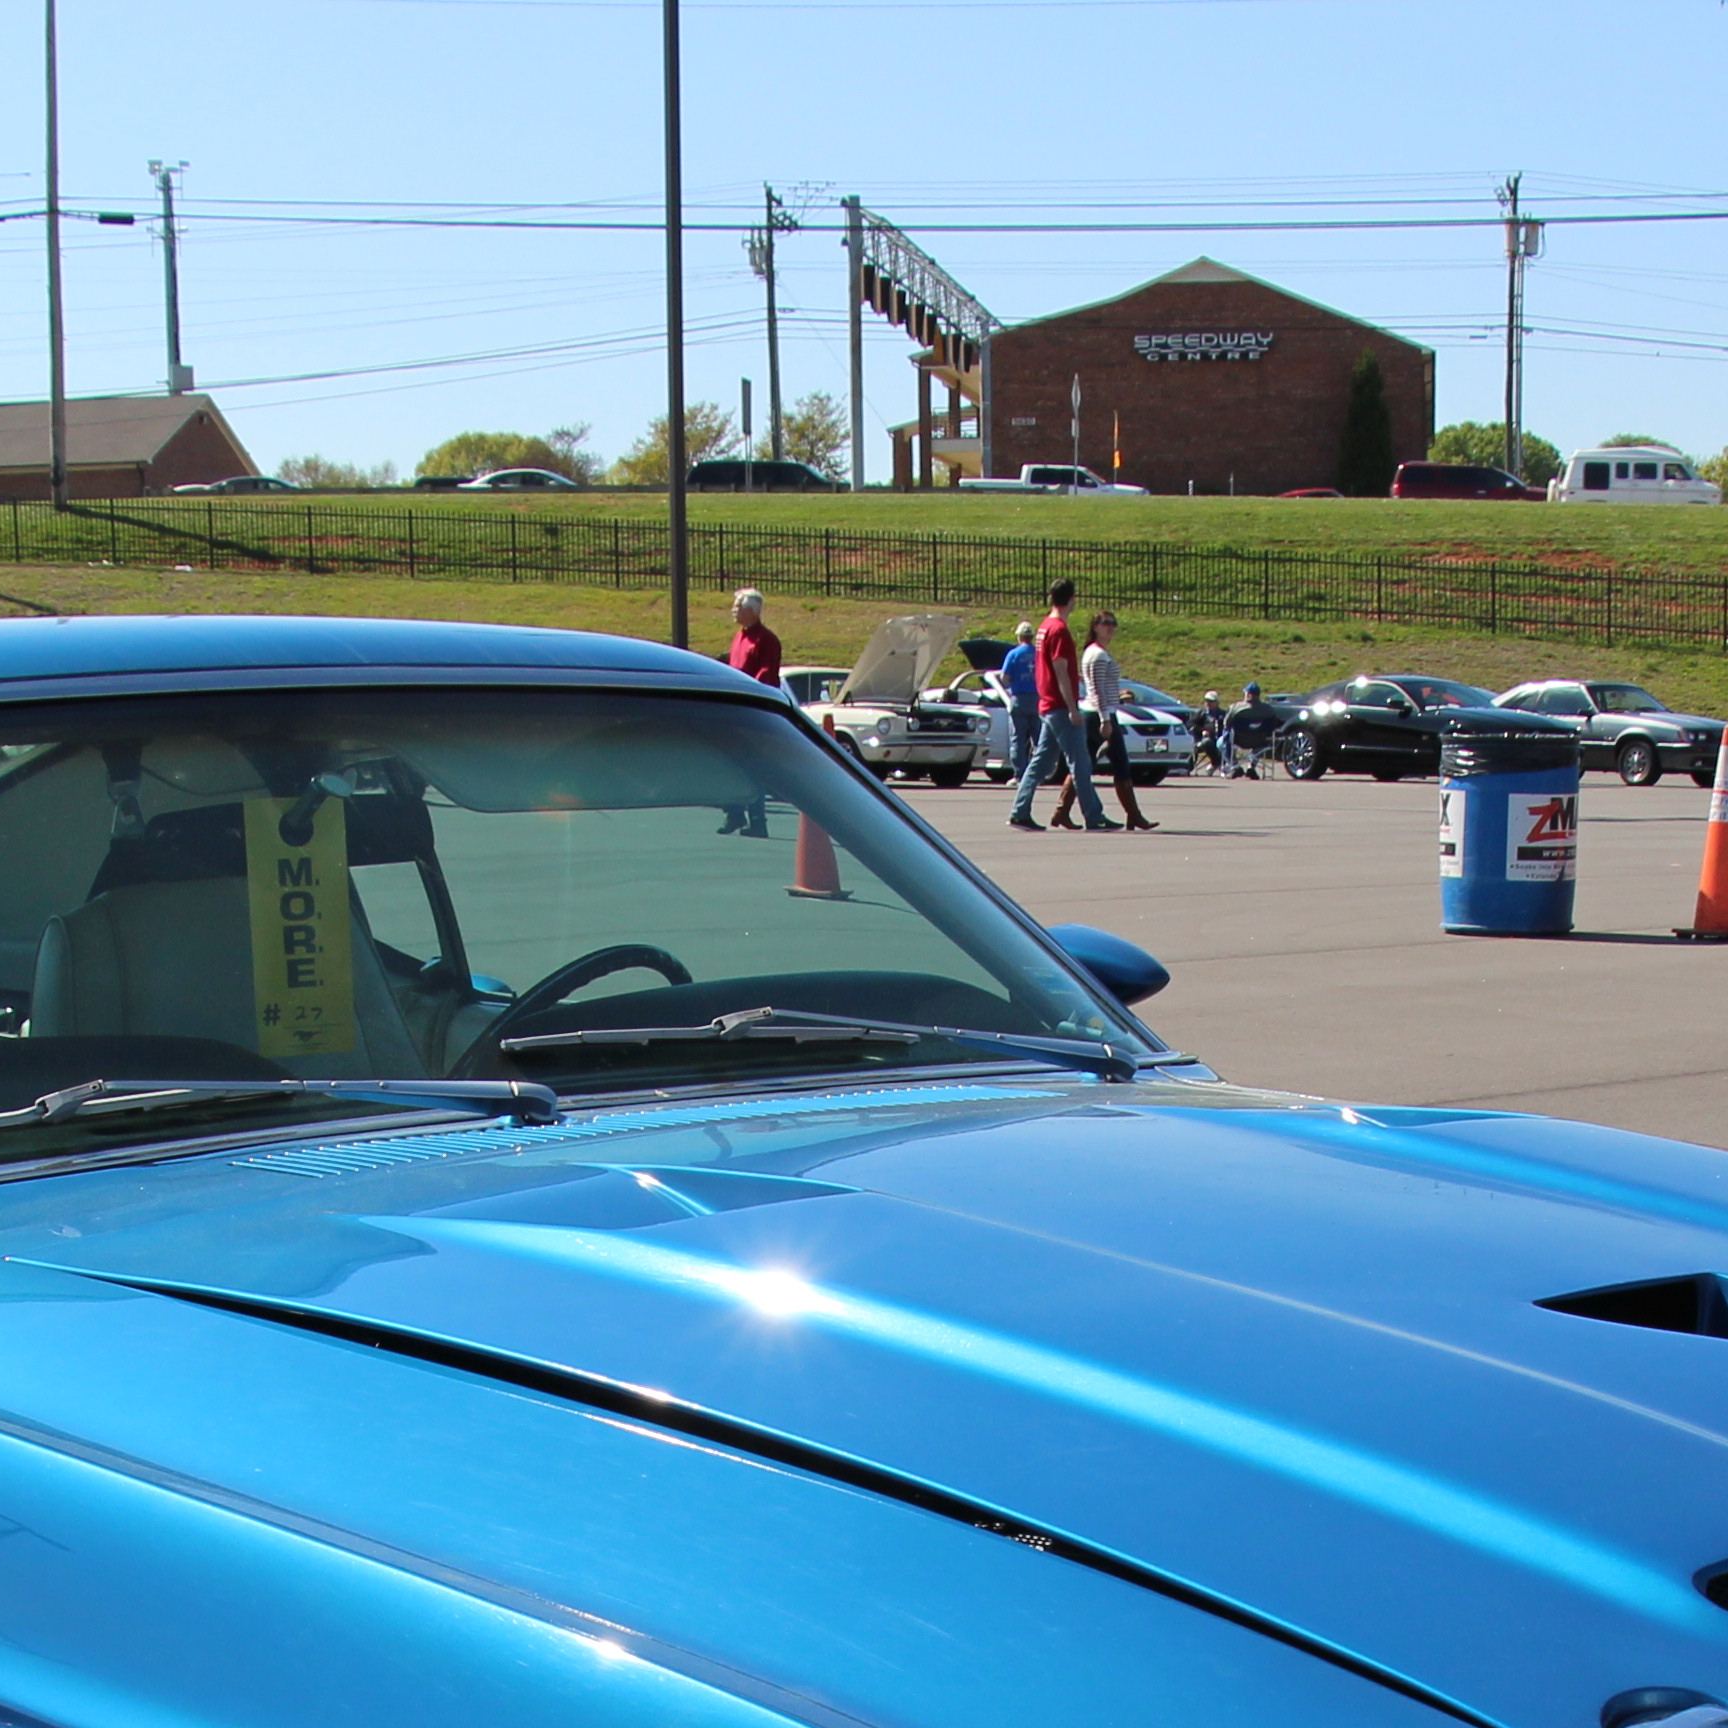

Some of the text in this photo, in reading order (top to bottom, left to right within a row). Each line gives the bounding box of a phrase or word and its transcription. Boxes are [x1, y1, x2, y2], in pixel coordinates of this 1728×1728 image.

[1133, 332, 1274, 348] SPEEDWAY
[1146, 351, 1261, 361] CENTRE
[294, 1004, 324, 1022] 27
